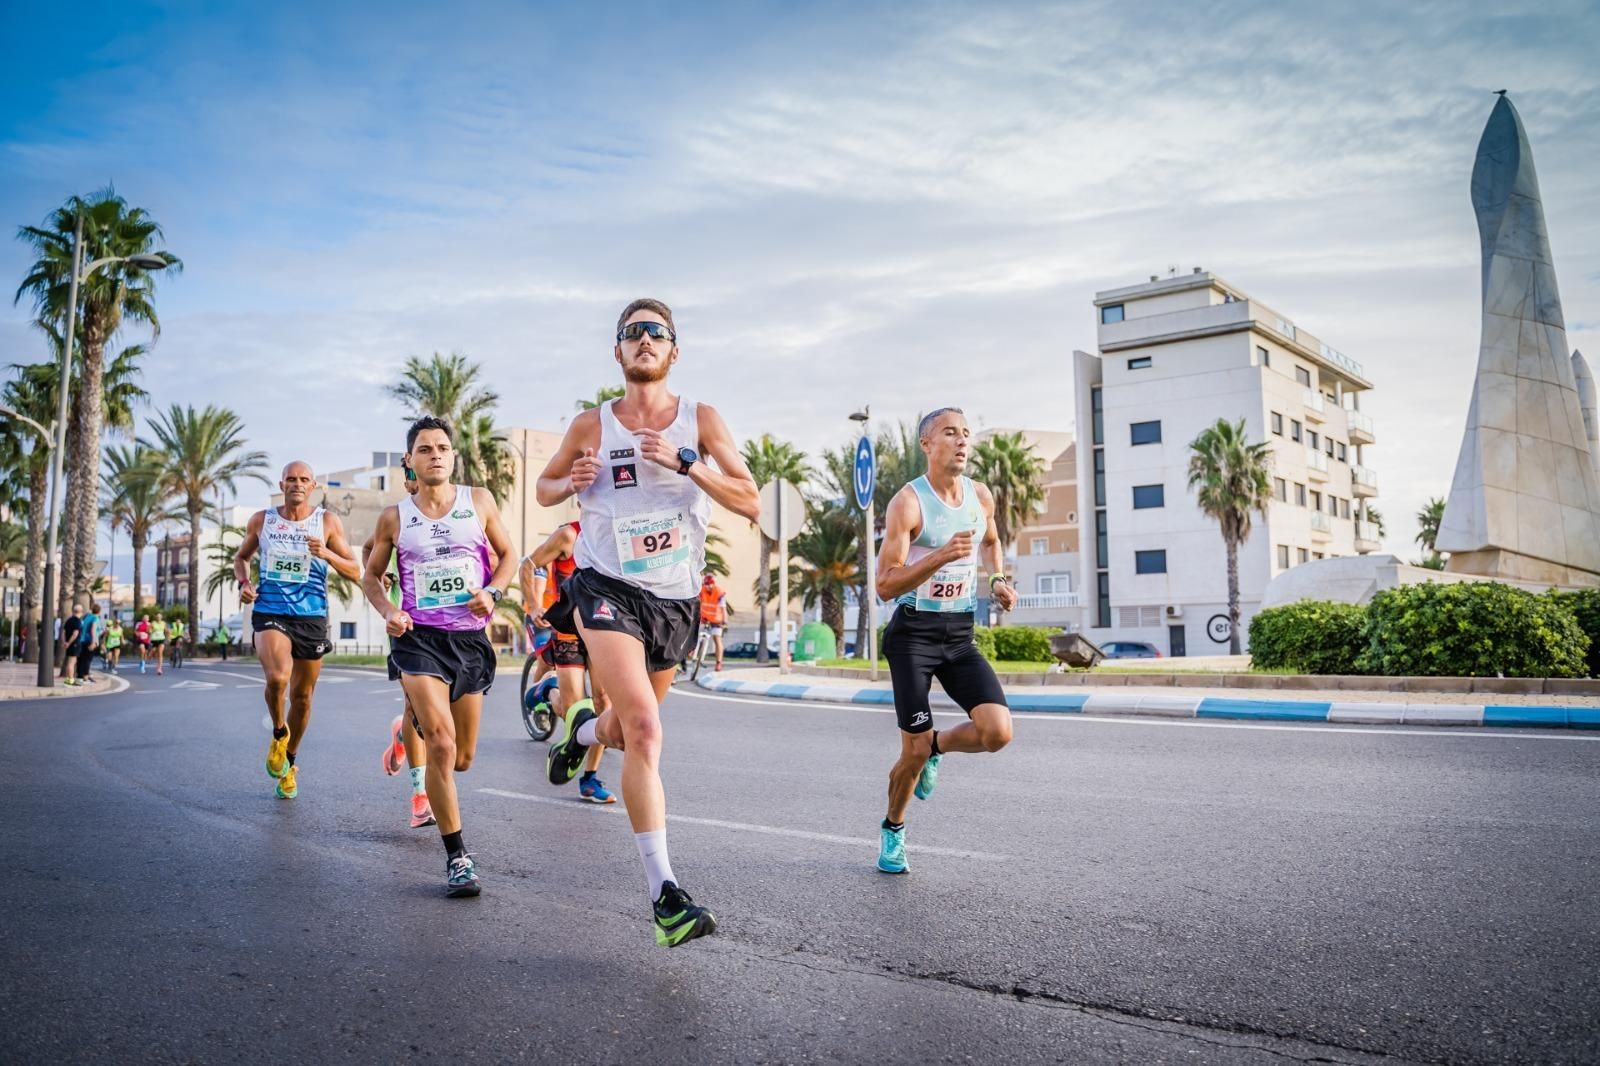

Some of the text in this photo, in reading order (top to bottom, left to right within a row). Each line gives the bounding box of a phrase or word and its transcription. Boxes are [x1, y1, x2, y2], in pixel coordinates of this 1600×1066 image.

[269, 533, 308, 541] MARACEN
[643, 532, 672, 553] 92
[275, 561, 301, 572] 545
[429, 577, 465, 593] 459
[932, 583, 963, 597] 281
